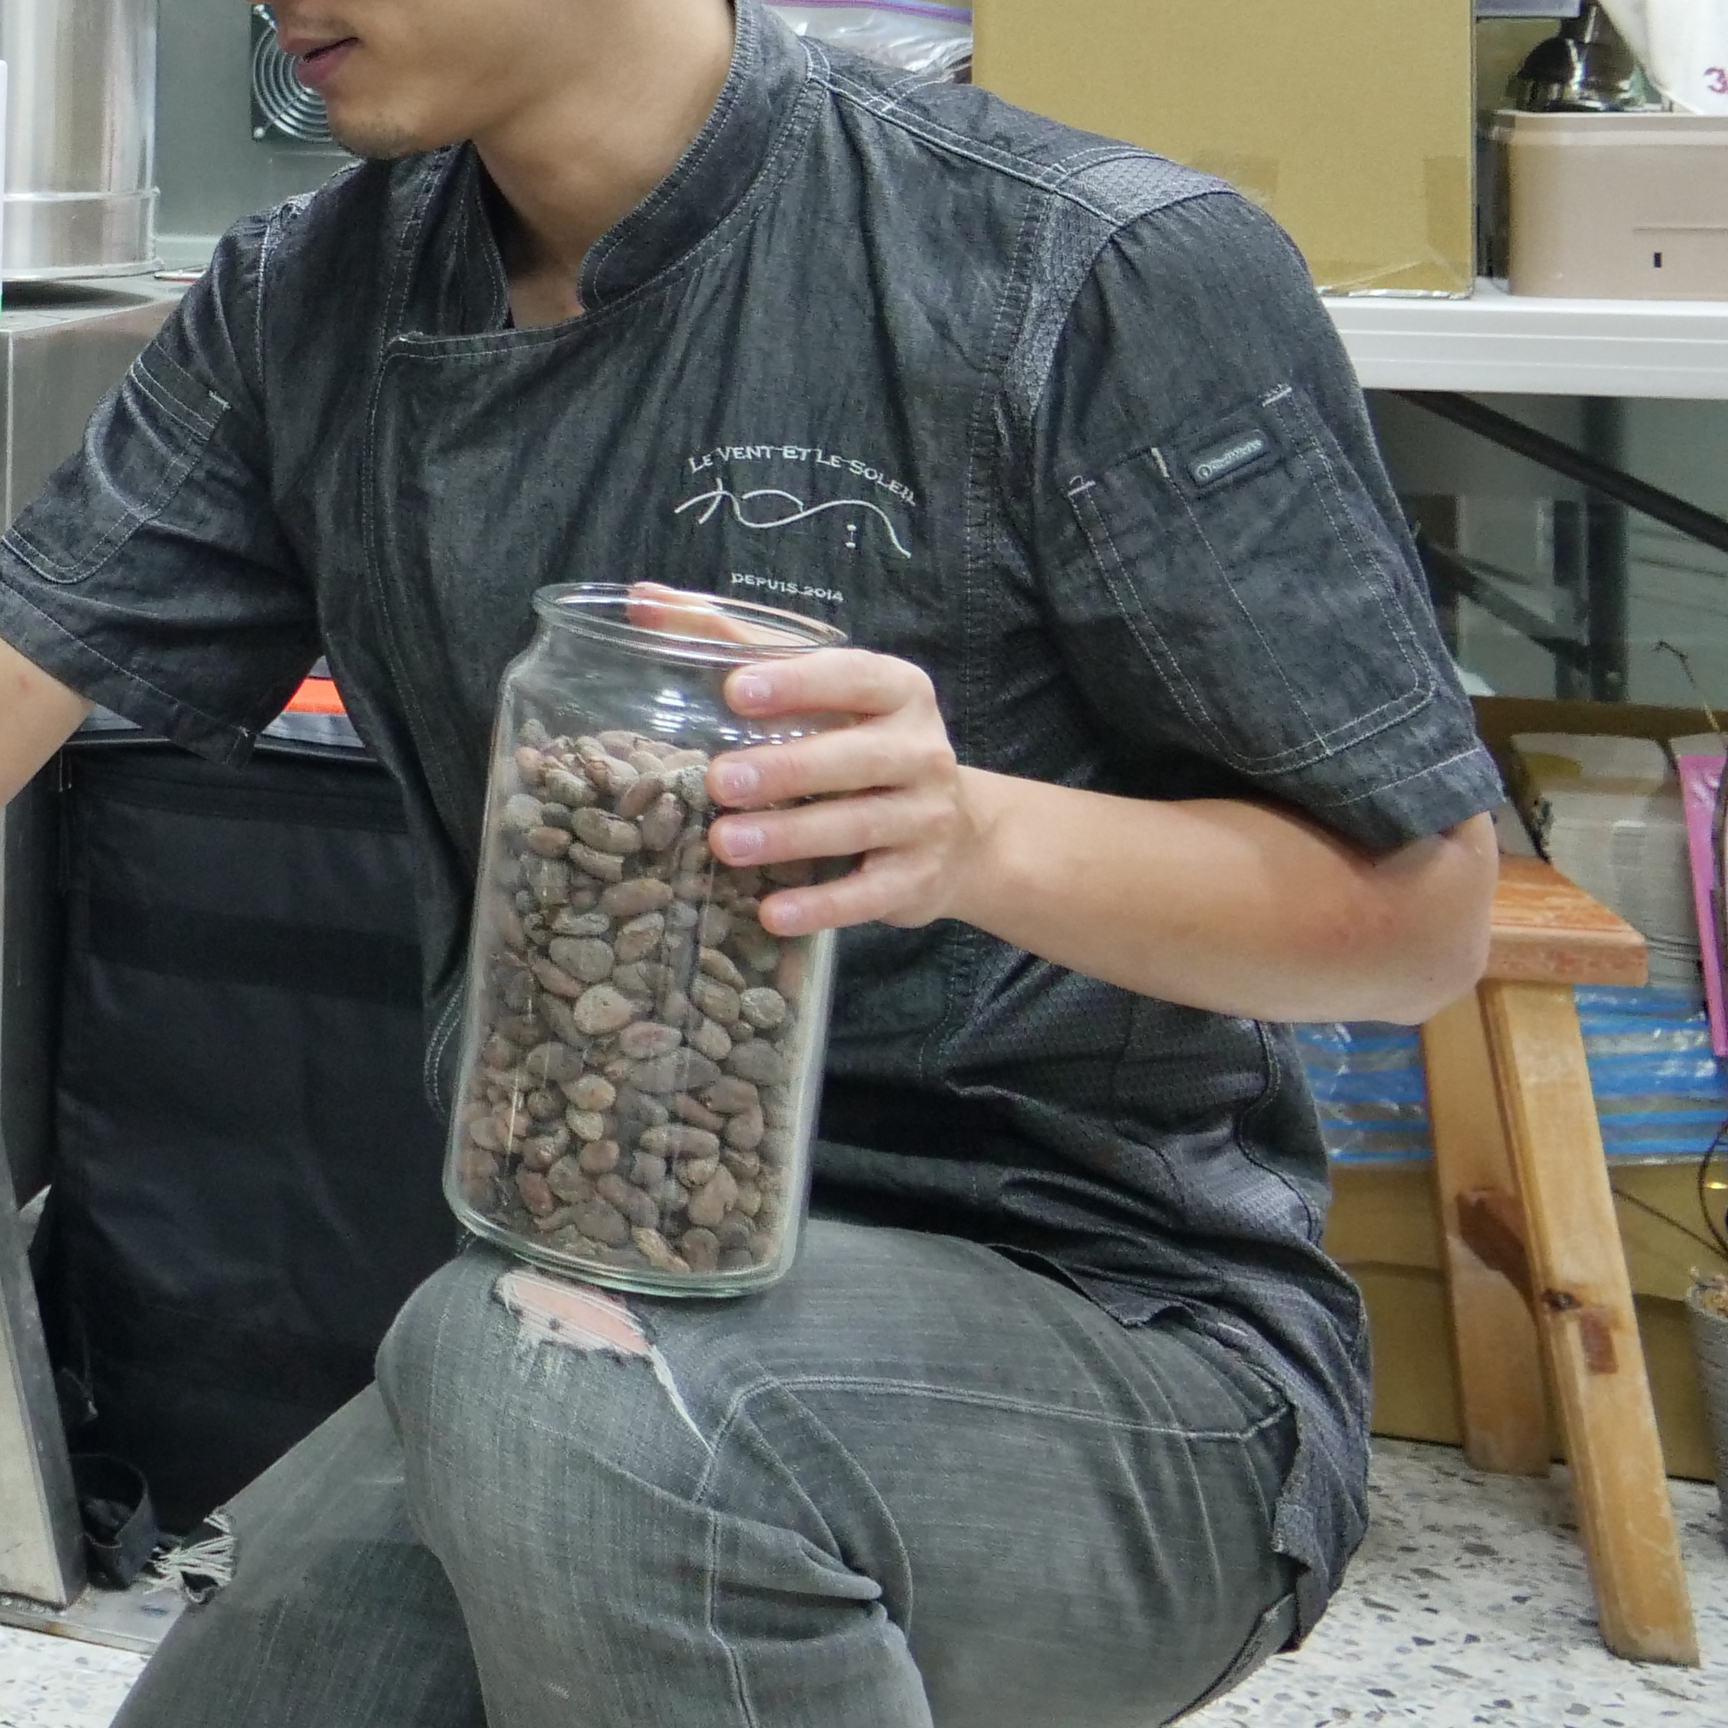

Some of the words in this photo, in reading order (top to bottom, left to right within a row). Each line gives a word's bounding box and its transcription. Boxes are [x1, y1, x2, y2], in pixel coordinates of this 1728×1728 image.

[715, 444, 777, 463] VENT
[781, 444, 812, 462] ET
[848, 459, 918, 508] SOLEIL
[731, 571, 798, 595] DEPUIS
[803, 584, 845, 604] 2014
